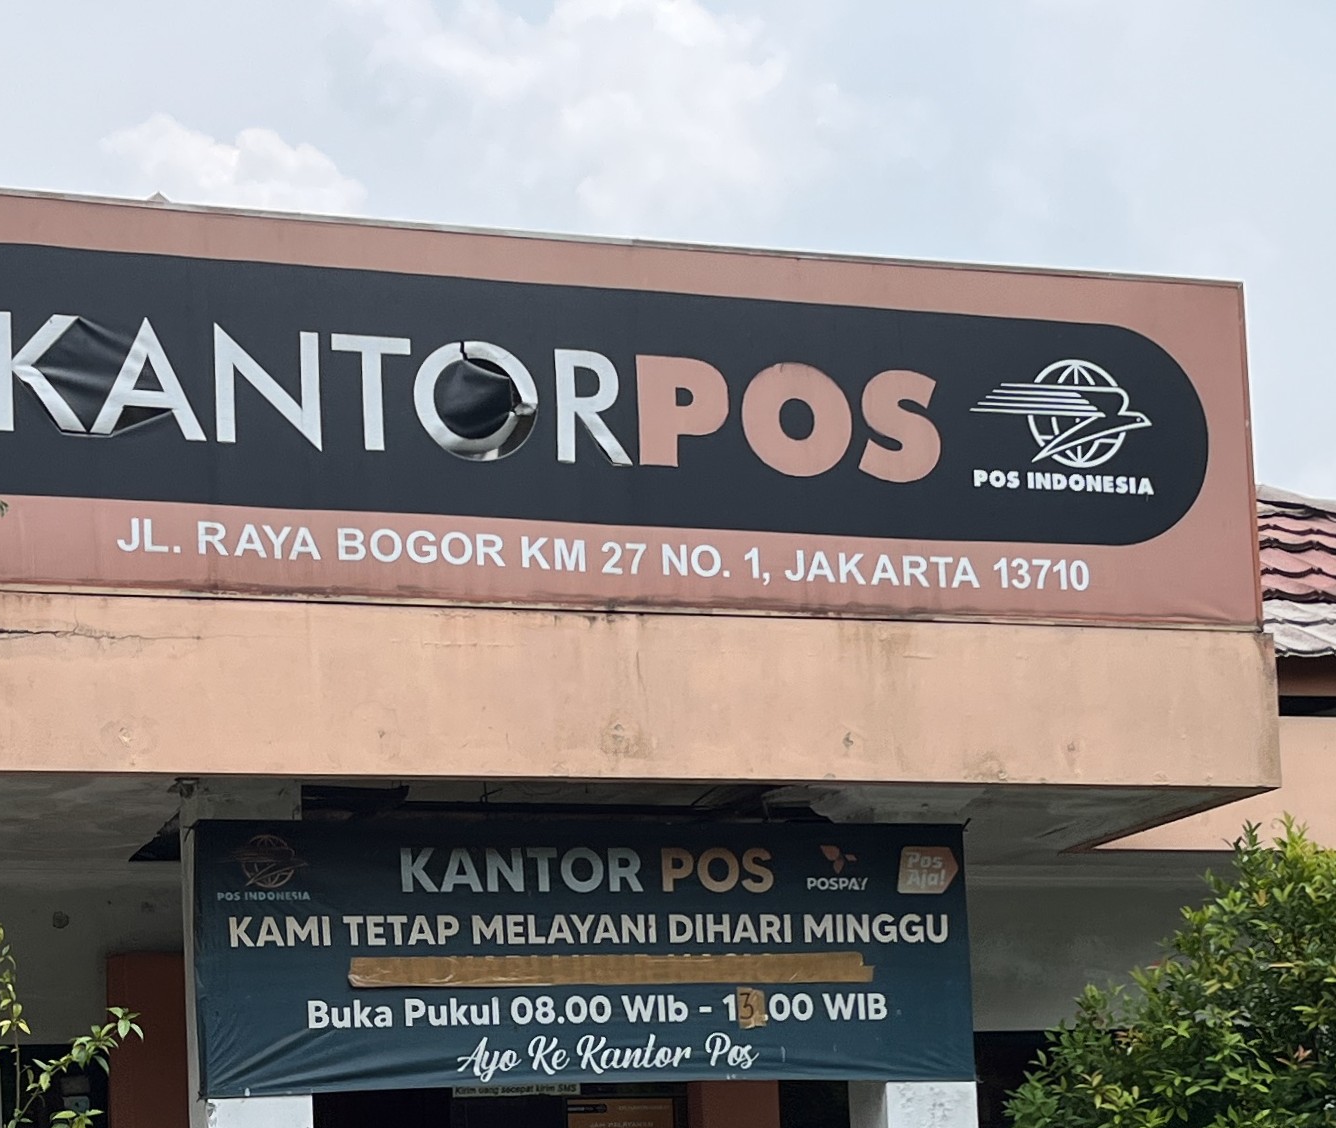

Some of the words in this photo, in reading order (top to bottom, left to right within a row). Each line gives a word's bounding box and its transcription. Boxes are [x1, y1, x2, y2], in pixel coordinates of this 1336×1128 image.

[972, 468, 1020, 490] POS
[1027, 471, 1155, 495] INDONESIA
[117, 517, 182, 556] JL.
[197, 521, 322, 562] RAYA
[337, 527, 507, 568] BOGOR
[520, 535, 588, 573] KM
[601, 540, 647, 575] 27
[661, 543, 731, 579] NO.
[743, 547, 771, 586] 1,
[784, 549, 977, 590] JAKARTA
[991, 557, 1091, 592] 13710
[400, 846, 645, 894] KANTOR
[661, 846, 775, 894] POS
[906, 851, 944, 869] Pos
[806, 877, 869, 891] POSPAY
[906, 868, 947, 889] Aja!
[217, 891, 241, 902] POS
[245, 891, 311, 902] INDONESIA
[228, 915, 332, 948] KAMI
[342, 914, 460, 946] TETAP
[471, 913, 657, 945] MELAYANI
[668, 913, 792, 944] DIHARI
[804, 912, 949, 944] MINGGU
[307, 998, 393, 1030] Buka
[404, 996, 500, 1028] Pukul
[510, 994, 612, 1026] 08.00
[621, 994, 689, 1024] WIb
[822, 992, 888, 1021] WIB
[456, 1036, 522, 1083] Ayo
[527, 1035, 570, 1076] Ke
[575, 1033, 692, 1074] Kantor
[704, 1032, 761, 1071] Pos
[557, 1083, 577, 1093] SMS
